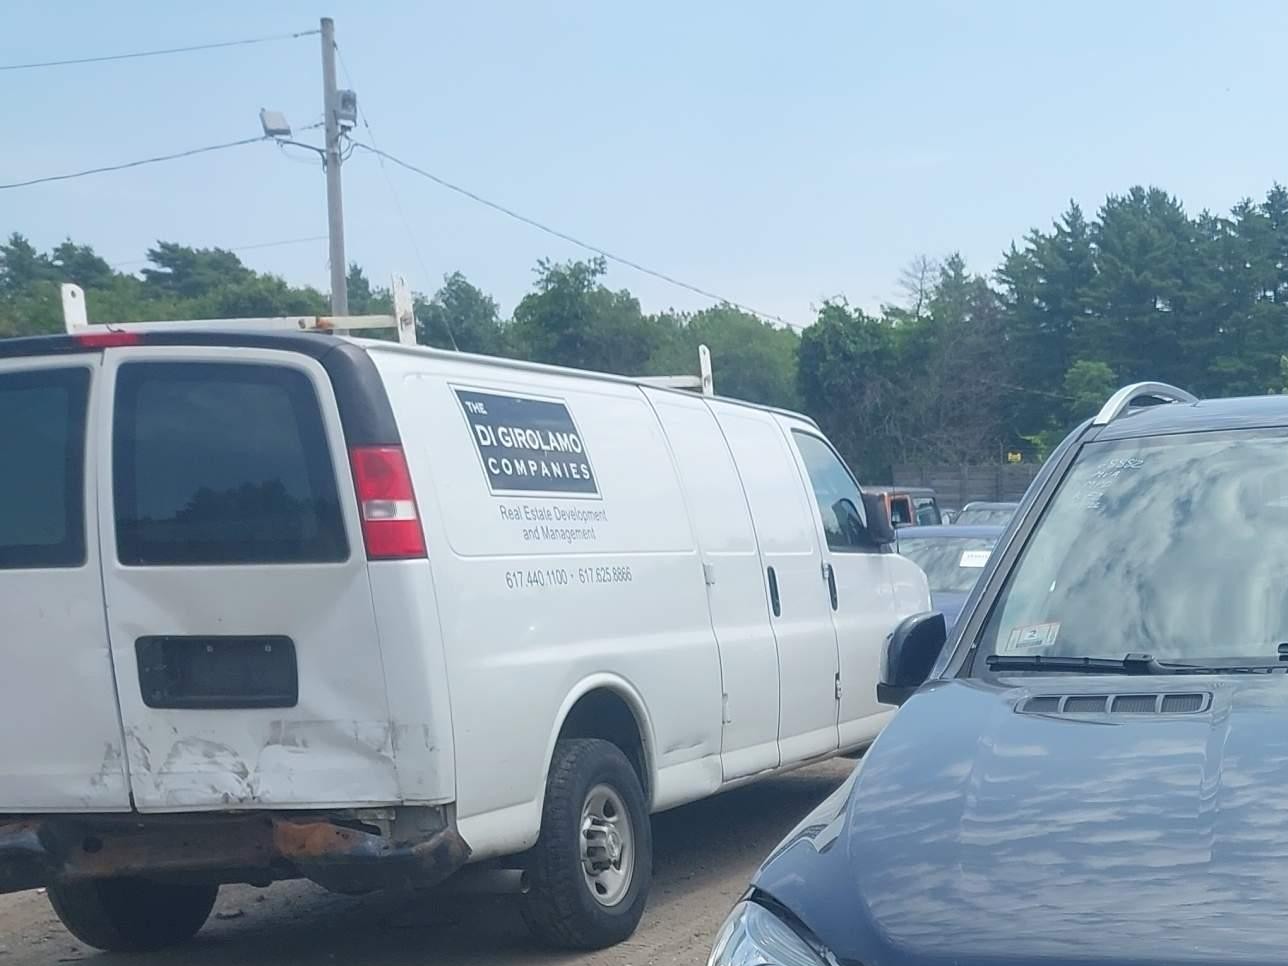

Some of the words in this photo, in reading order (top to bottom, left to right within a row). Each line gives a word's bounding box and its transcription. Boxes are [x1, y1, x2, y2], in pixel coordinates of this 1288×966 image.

[465, 401, 488, 415] THE
[474, 423, 497, 447] DI
[498, 425, 584, 453] GIROLAMO
[487, 457, 591, 480] COMPANIES
[499, 505, 523, 521] Real
[523, 505, 553, 521] Estate
[553, 506, 608, 524] Development
[522, 526, 541, 541] and
[541, 526, 597, 544] Management
[505, 569, 568, 589] 617.440.1100
